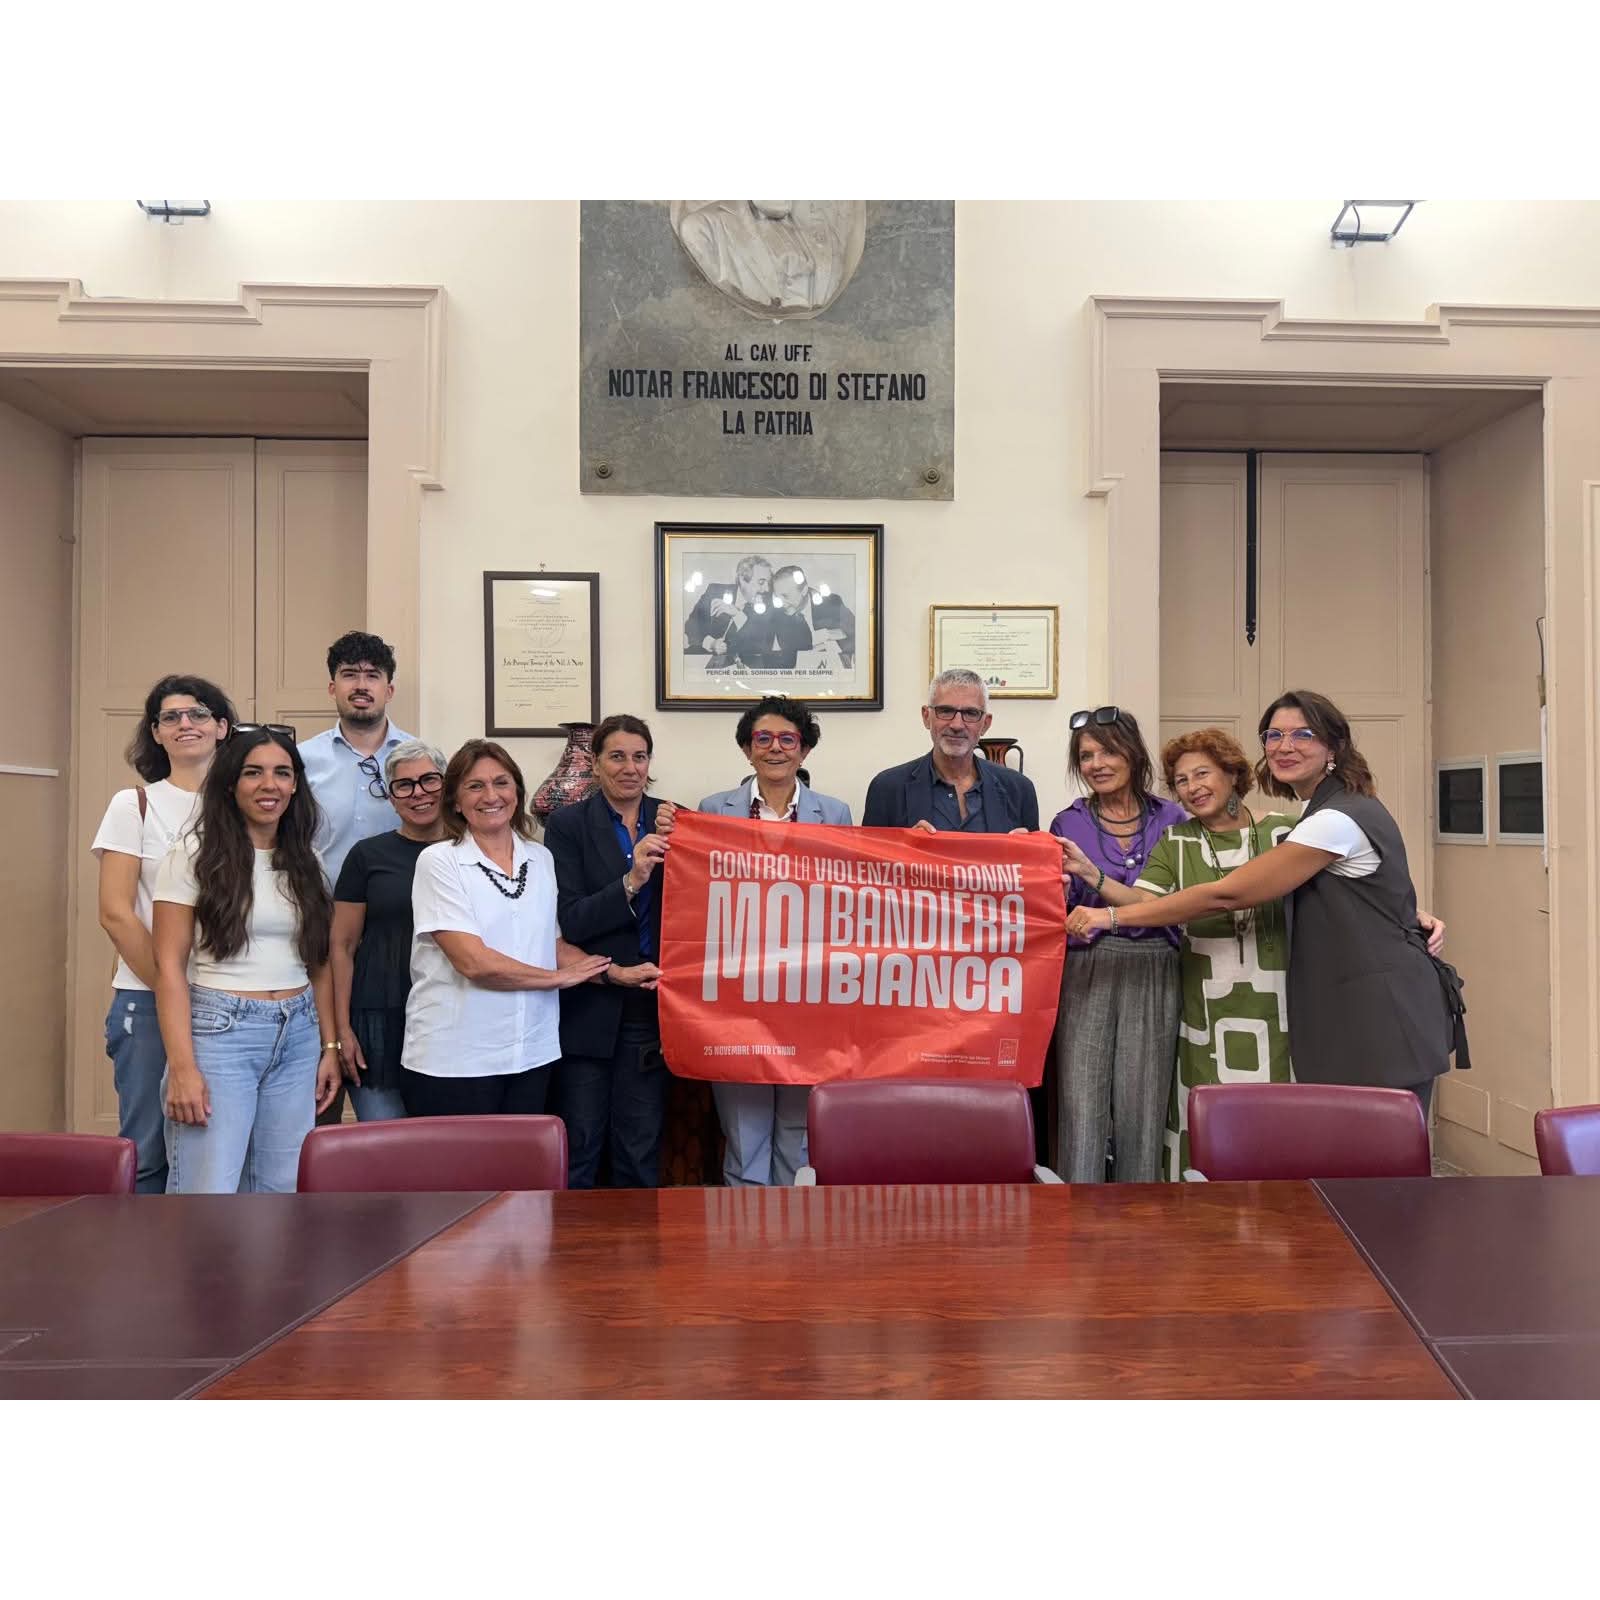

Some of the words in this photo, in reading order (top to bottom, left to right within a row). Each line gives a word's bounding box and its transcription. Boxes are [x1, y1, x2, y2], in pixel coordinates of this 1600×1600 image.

[724, 344, 744, 362] AL
[750, 344, 779, 362] CAV.
[784, 344, 813, 362] UFF.
[608, 368, 673, 399] NOTAR
[683, 370, 799, 400] FRANCESCO
[809, 372, 828, 401] DI
[837, 373, 926, 401] STEFANO
[722, 410, 745, 435] LA
[754, 410, 814, 436] PATRIA
[709, 850, 790, 881] CONTRO
[794, 854, 810, 881] LA
[813, 858, 905, 886] VIOLENZA
[909, 863, 950, 891] SULLE
[953, 863, 1025, 892] DONNE
[830, 884, 1026, 954] BANDIERA
[702, 880, 825, 1004] MAI
[828, 951, 1024, 1014] BIANCA
[703, 1045, 713, 1056] 25
[714, 1045, 750, 1056] NOVEMBRE
[751, 1044, 772, 1055] TUTTO
